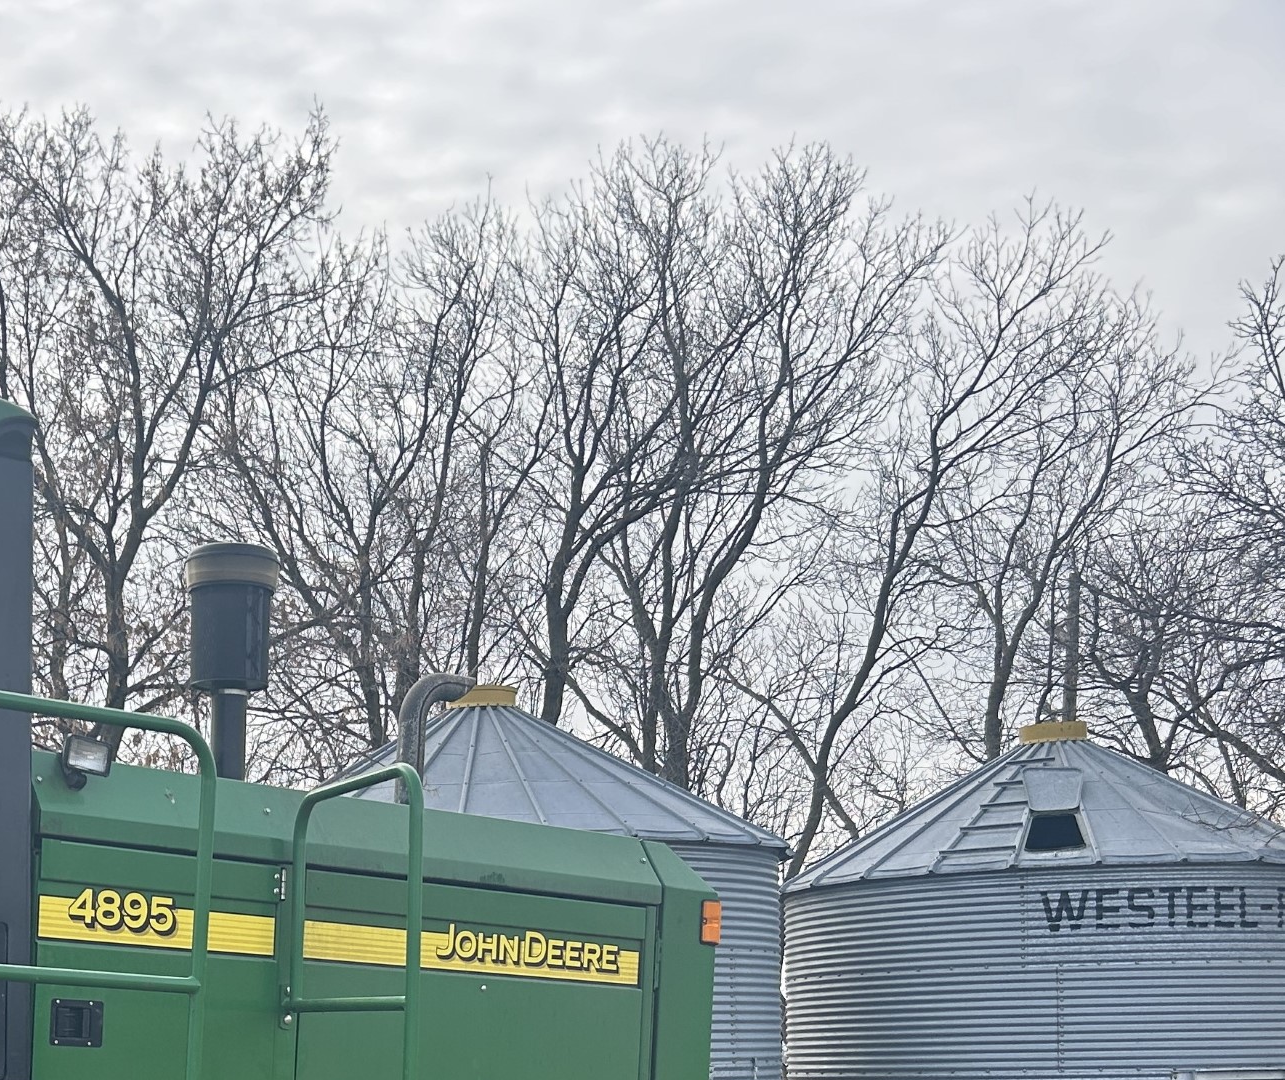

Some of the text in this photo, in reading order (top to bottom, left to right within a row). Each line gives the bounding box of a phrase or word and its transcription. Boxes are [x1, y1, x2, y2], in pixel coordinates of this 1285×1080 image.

[68, 889, 175, 935] 4895
[437, 923, 619, 973] JOHN DEERE
